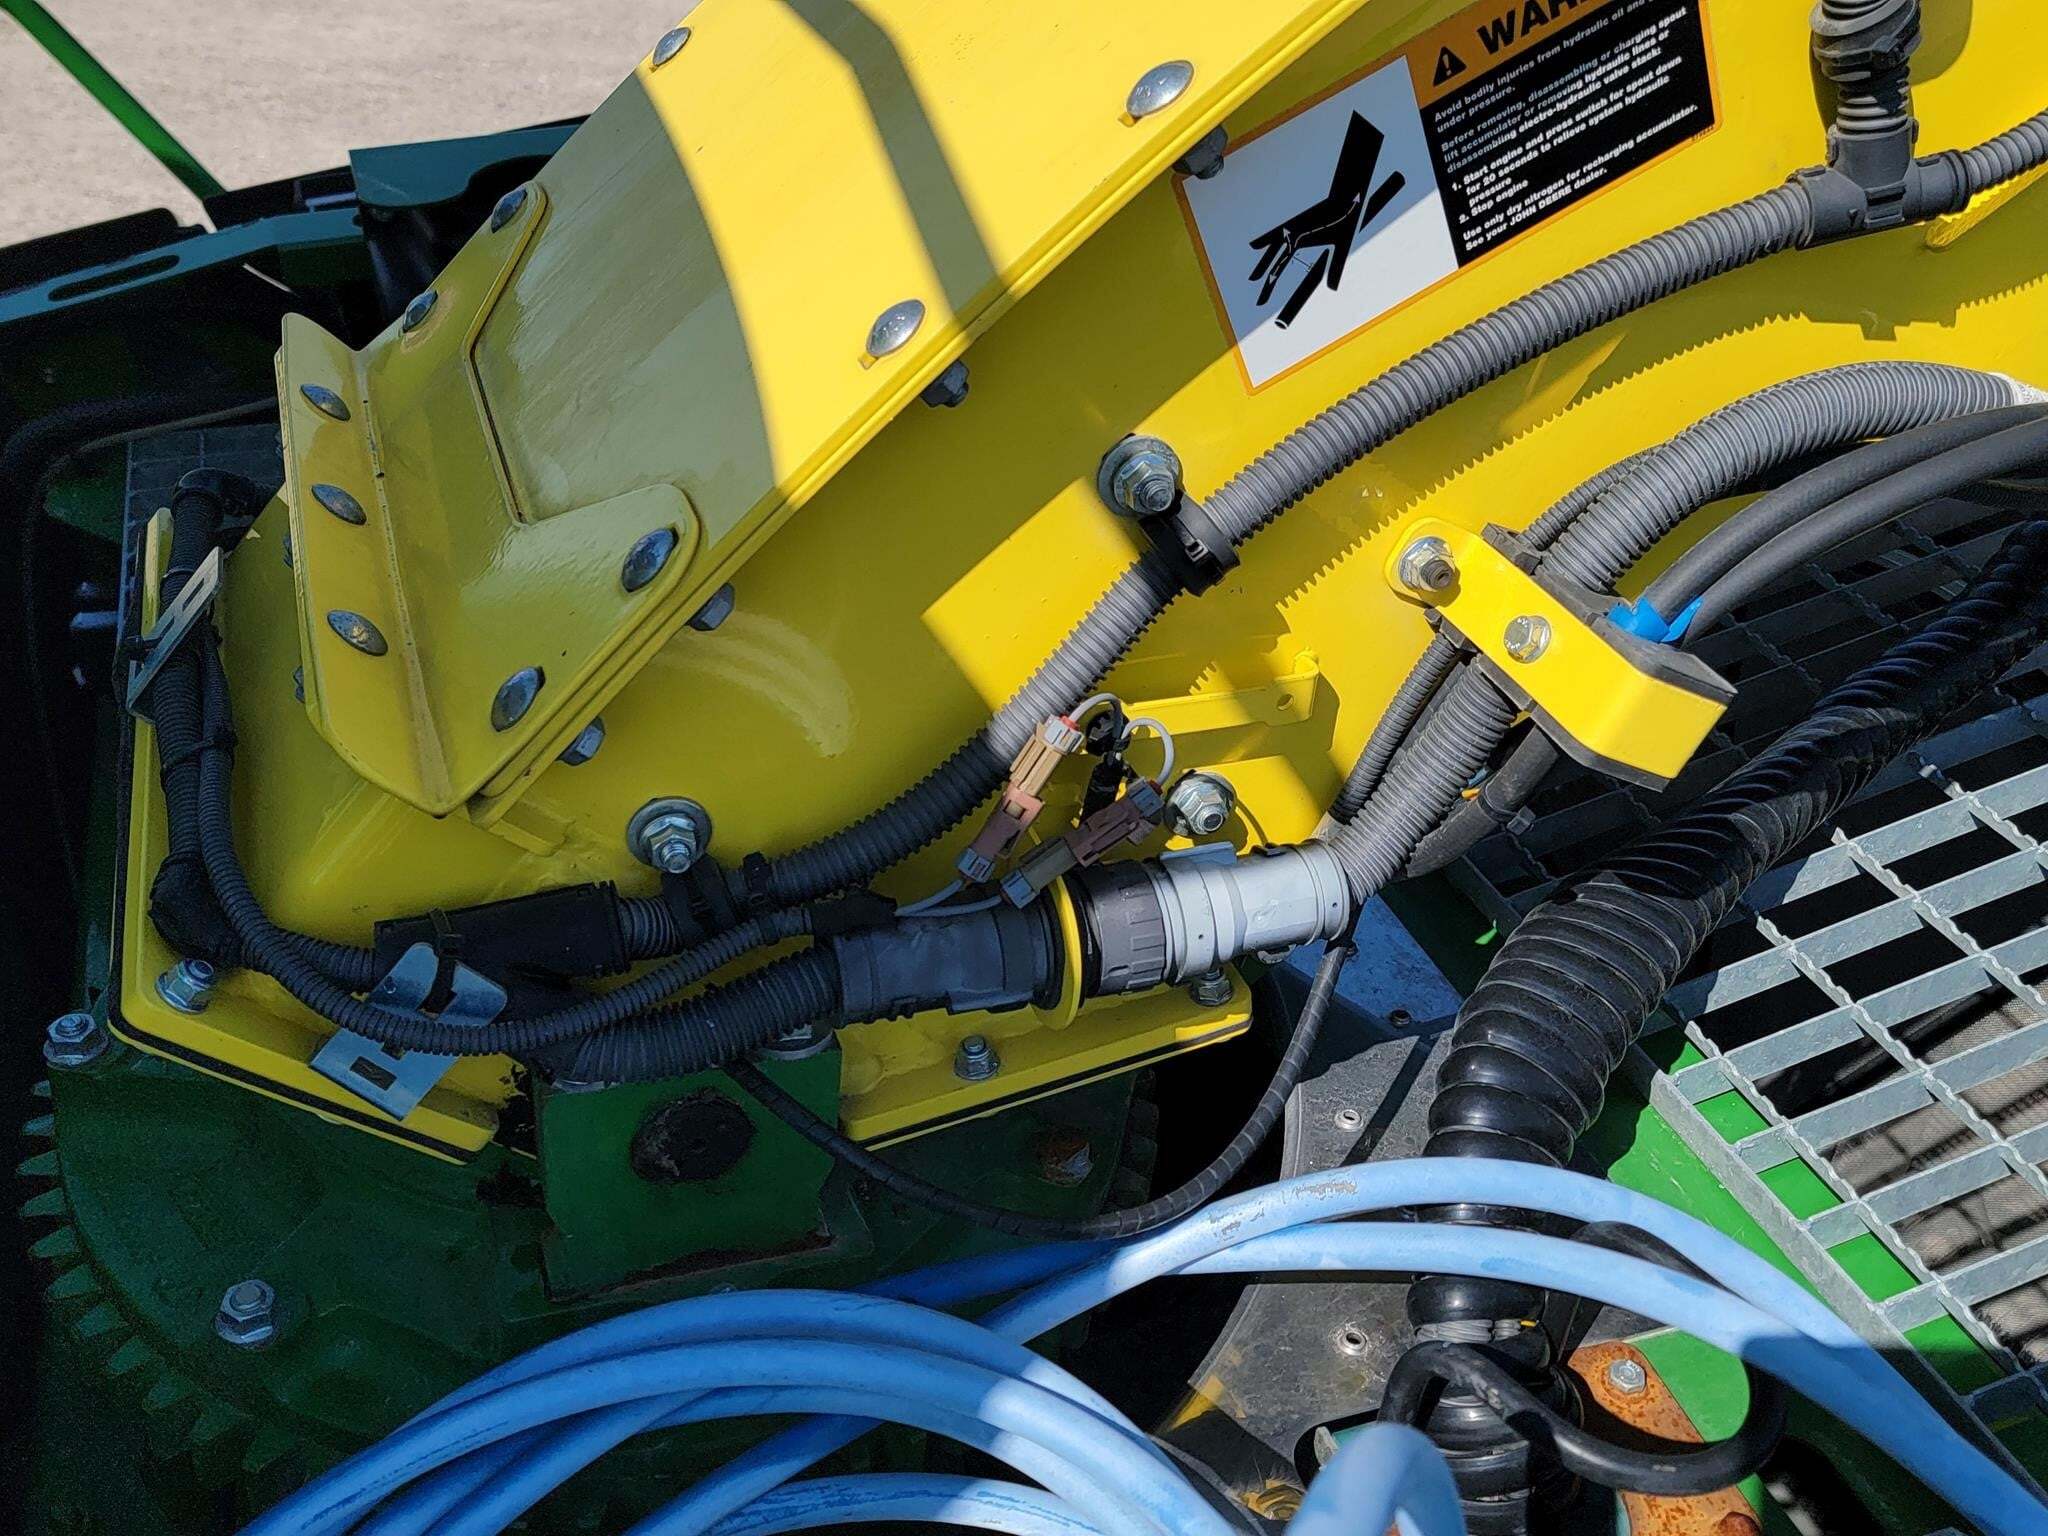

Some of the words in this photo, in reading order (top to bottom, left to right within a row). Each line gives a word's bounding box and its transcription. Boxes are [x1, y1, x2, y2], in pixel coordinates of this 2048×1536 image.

[1435, 99, 1462, 122] Avoid
[1464, 82, 1494, 105] bodily
[1497, 60, 1535, 86] injuries
[1537, 45, 1561, 63] from
[1562, 17, 1609, 48] hydraulic
[1611, 7, 1624, 21] oil
[1437, 111, 1466, 133] under
[1468, 86, 1516, 117] pressure.
[1441, 129, 1474, 152] Before
[1477, 101, 1526, 132] removing,
[1528, 58, 1598, 102] disassembling
[1600, 50, 1611, 61] or
[1614, 24, 1657, 54] charging
[1658, 6, 1687, 29] spout
[1444, 149, 1459, 163] lift
[1461, 113, 1522, 153] accumulator
[1524, 106, 1535, 117] or
[1537, 79, 1583, 110] removing
[1584, 52, 1630, 83] hydraulic
[1631, 37, 1657, 56] lines
[1658, 29, 1669, 41] or
[1447, 129, 1517, 173] disassembling
[1518, 81, 1602, 133] electro-hydraulic
[1603, 65, 1630, 84] valve
[1631, 46, 1661, 69] stack:
[1451, 182, 1462, 191] 1.
[1463, 165, 1489, 185] Start
[1490, 146, 1523, 170] engine
[1525, 132, 1544, 150] and
[1545, 117, 1574, 140] press
[1575, 98, 1608, 122] switch
[1609, 88, 1624, 102] for
[1625, 70, 1654, 93] spout
[1655, 56, 1682, 80] down
[1463, 226, 1482, 241] Use
[1484, 212, 1504, 229] only
[1506, 202, 1522, 216] dry
[1524, 179, 1565, 206] nitrogen
[1566, 169, 1581, 182] for
[1582, 139, 1635, 173] recharging
[1636, 104, 1698, 143] accumulator.
[1466, 182, 1481, 196] for
[1482, 172, 1496, 186] 20
[1498, 150, 1539, 177] seconds
[1540, 142, 1551, 153] to
[1553, 122, 1586, 146] relieve
[1588, 101, 1624, 126] system
[1624, 75, 1670, 106] hydraulic
[1469, 177, 1512, 208] pressure
[1458, 213, 1470, 224] 2.
[1471, 199, 1494, 216] Stop
[1495, 179, 1528, 202] engine
[1465, 236, 1484, 251] See
[1485, 222, 1508, 241] your
[1509, 204, 1537, 226] JOHN
[1538, 184, 1572, 210] DEERE
[1573, 167, 1607, 189] dealer.
